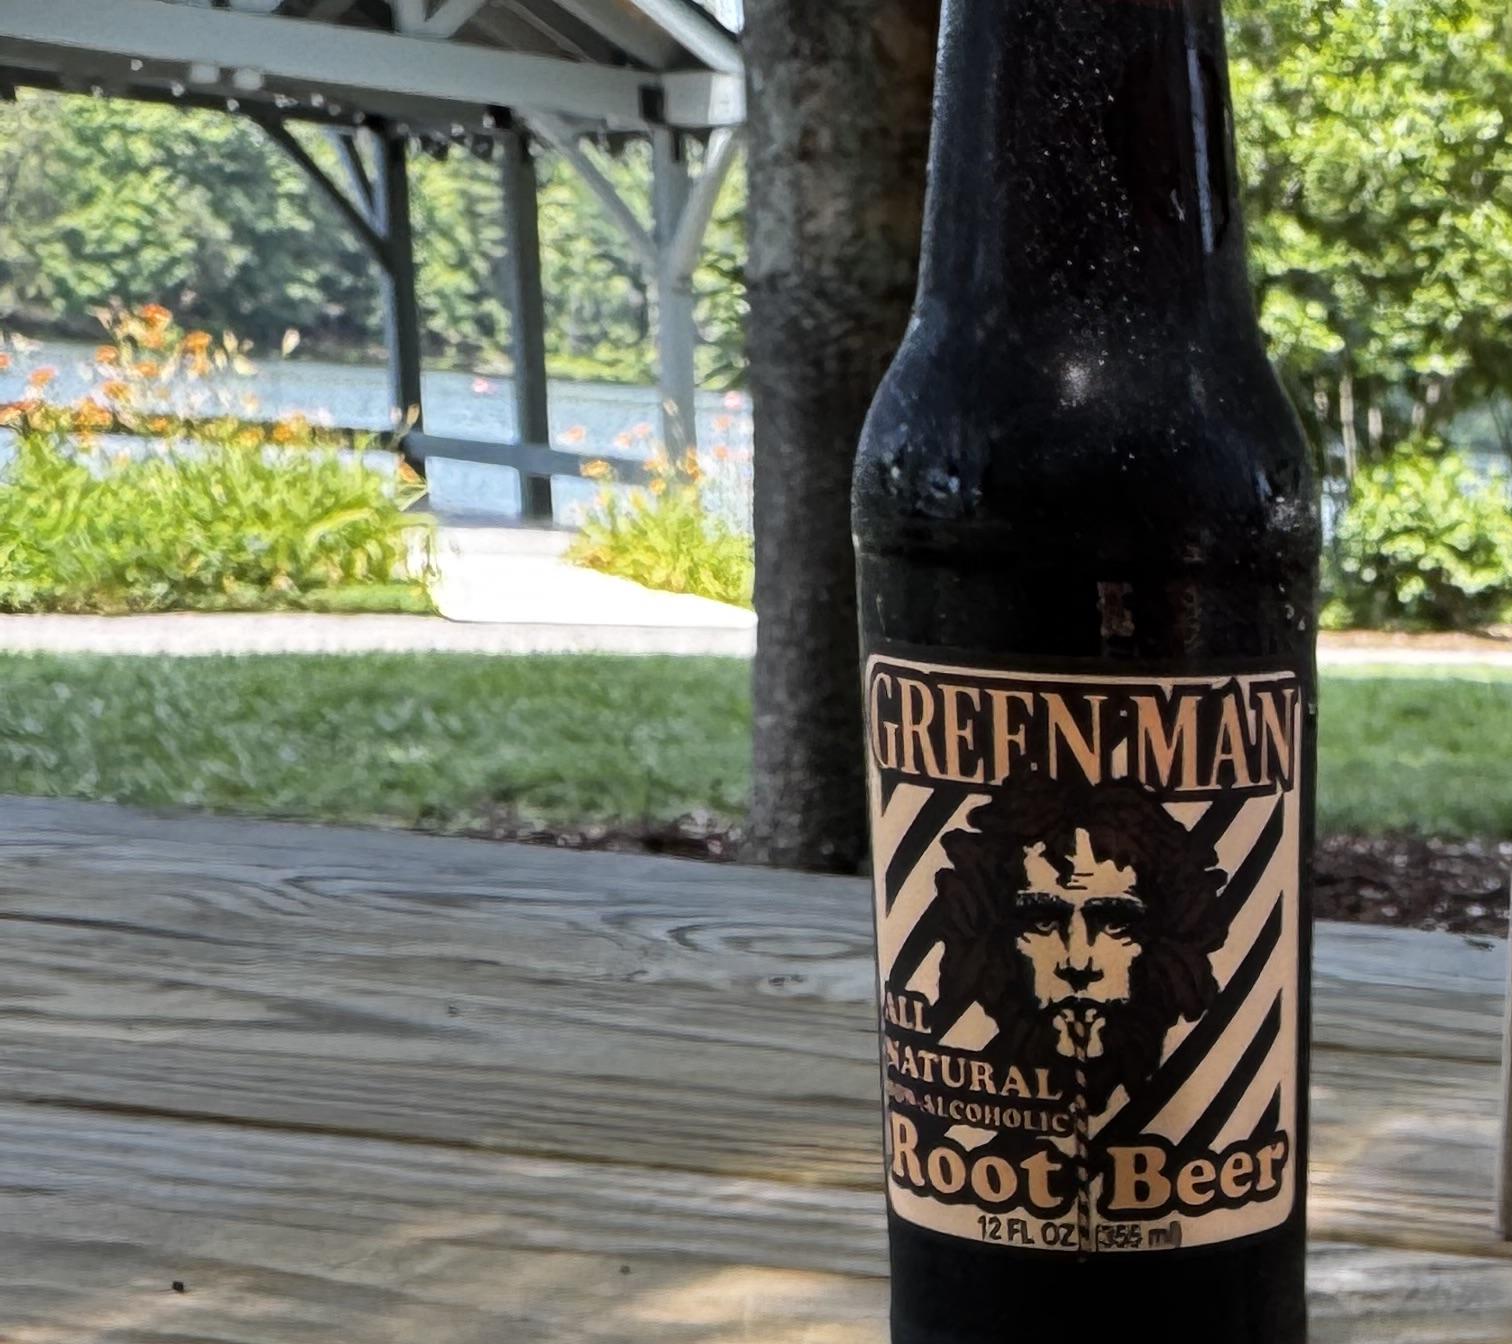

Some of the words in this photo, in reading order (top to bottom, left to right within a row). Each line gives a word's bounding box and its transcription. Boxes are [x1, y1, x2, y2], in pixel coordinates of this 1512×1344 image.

[871, 672, 1108, 786] GREEN
[1130, 687, 1295, 791] MAN
[885, 991, 932, 1034] ALL
[885, 1037, 1063, 1100] NATURAL
[891, 1112, 1062, 1208] Root
[1107, 1141, 1285, 1210] Beer
[977, 1214, 1002, 1241] 12
[1007, 1217, 1035, 1245] FL
[1041, 1221, 1078, 1247] OZ
